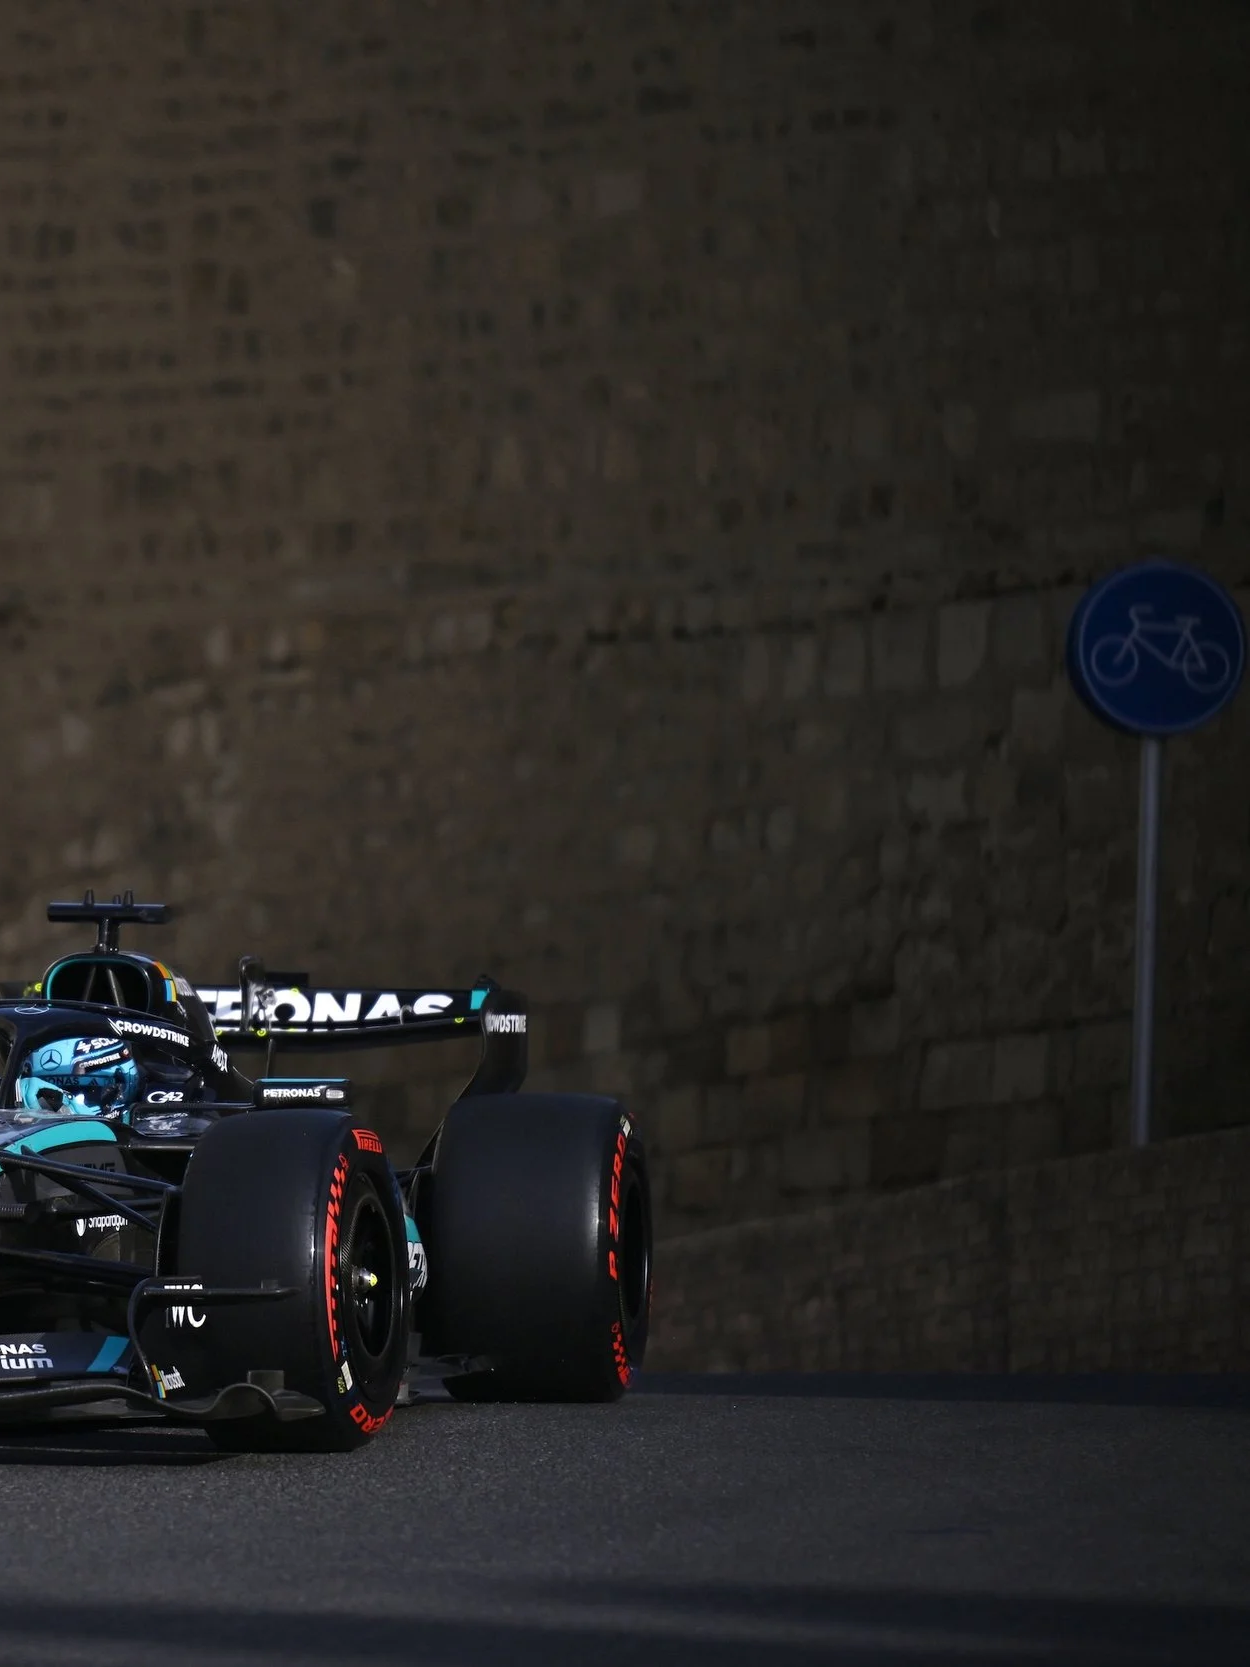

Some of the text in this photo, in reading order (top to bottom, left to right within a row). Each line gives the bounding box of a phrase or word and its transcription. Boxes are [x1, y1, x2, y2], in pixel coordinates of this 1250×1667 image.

[115, 1020, 189, 1048] CROWDSTRIKE
[78, 1052, 121, 1070] CROWDSTRIKE
[147, 1090, 184, 1104] G42
[263, 1088, 321, 1098] PETRONAS
[352, 1128, 382, 1153] PIRELLI
[609, 1132, 626, 1242] ZERO
